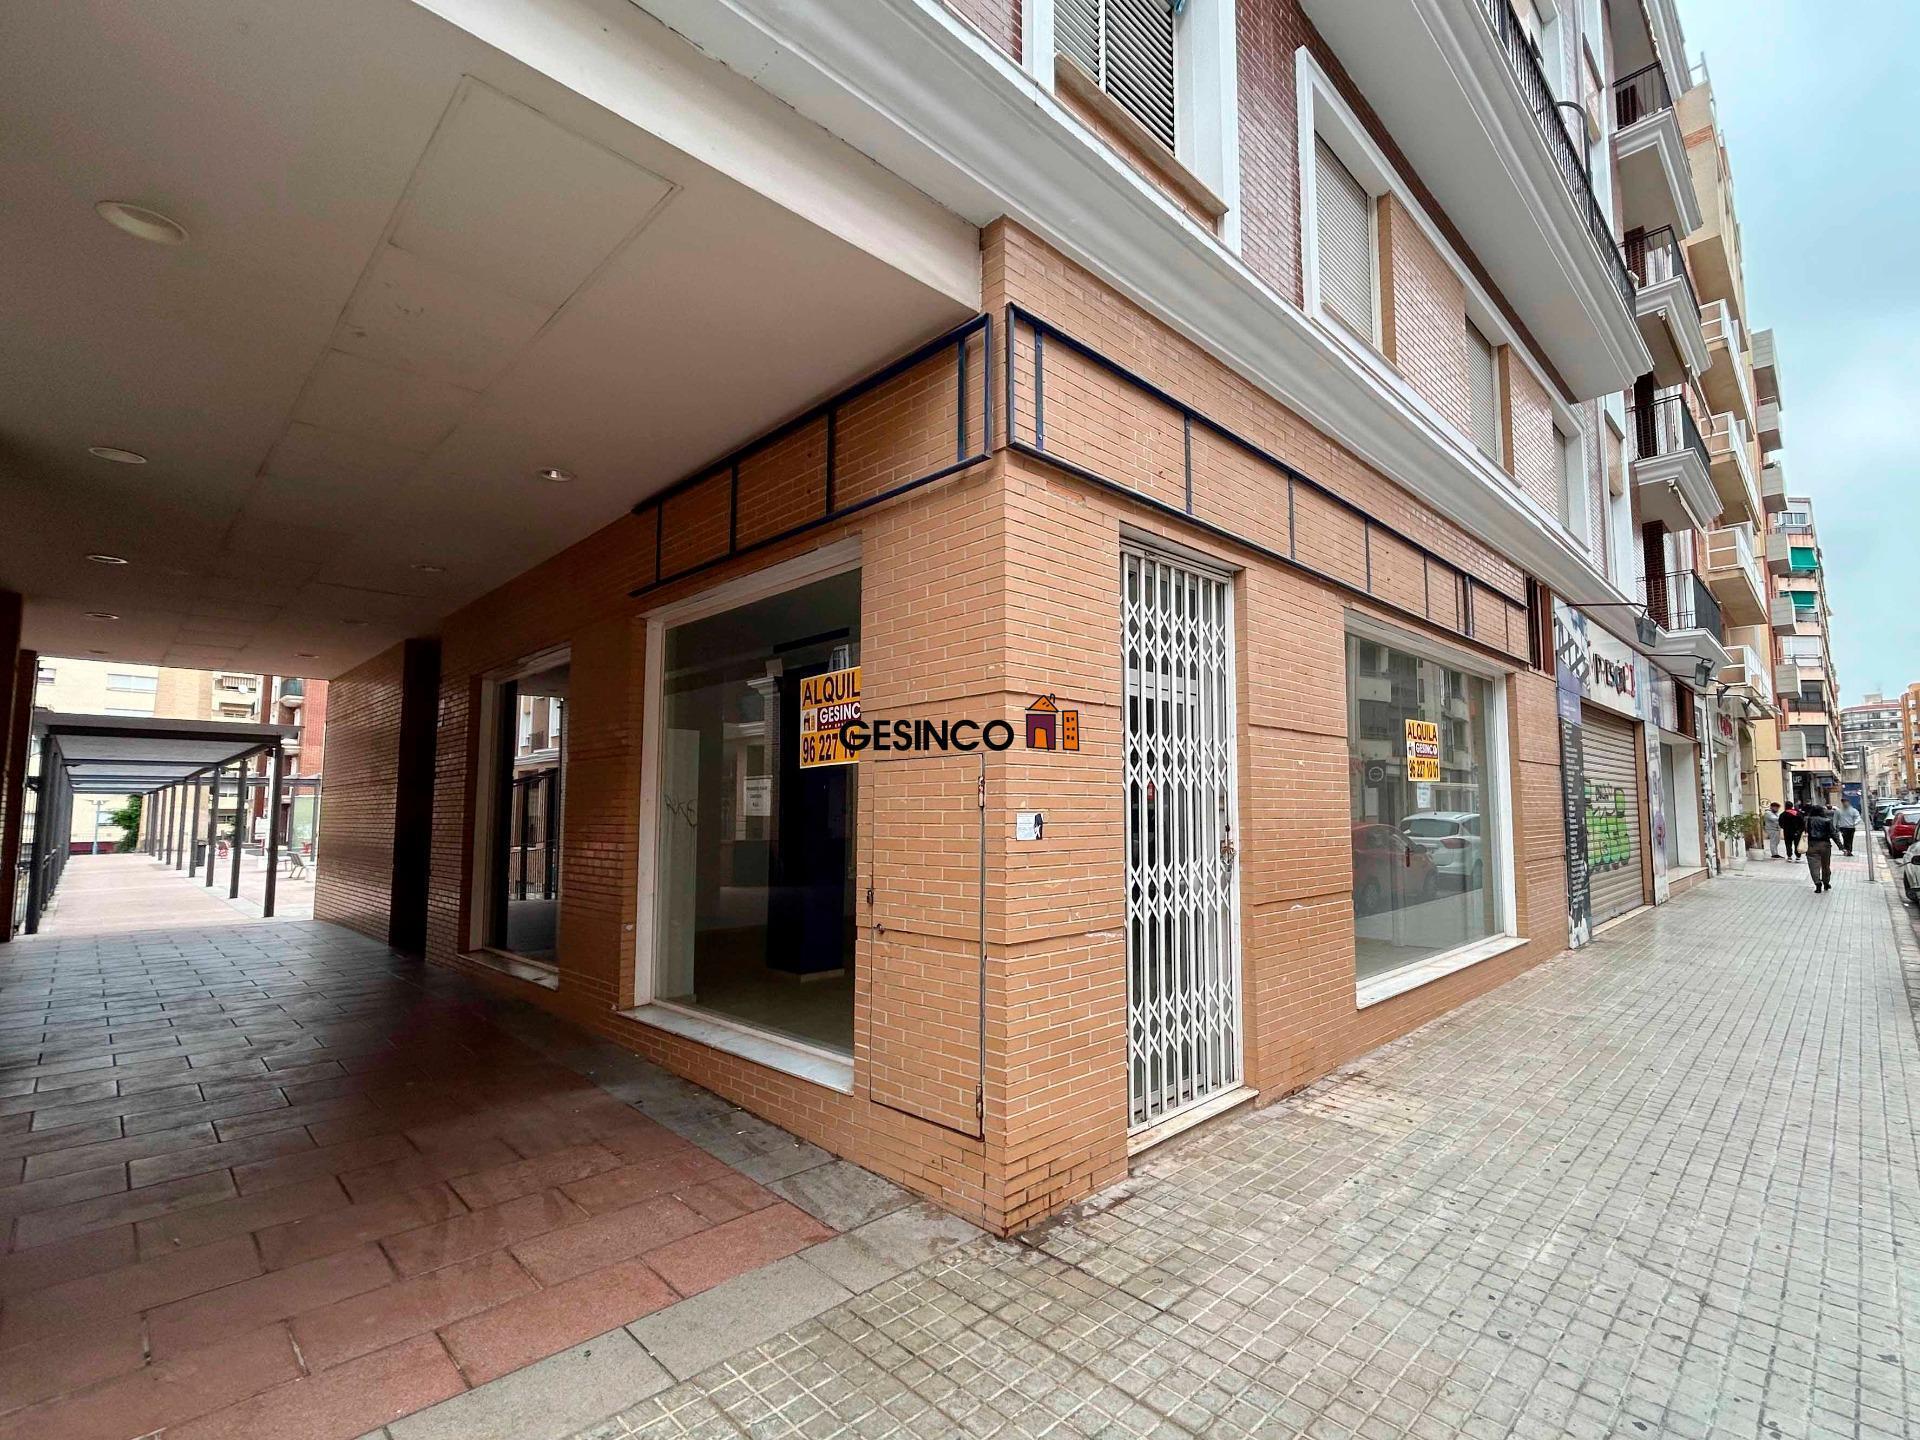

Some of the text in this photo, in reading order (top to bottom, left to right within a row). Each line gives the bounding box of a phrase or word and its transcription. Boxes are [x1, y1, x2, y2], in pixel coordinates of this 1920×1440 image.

[1408, 723, 1438, 742] ALQUILA
[803, 736, 815, 763] 96
[818, 732, 839, 762] 227
